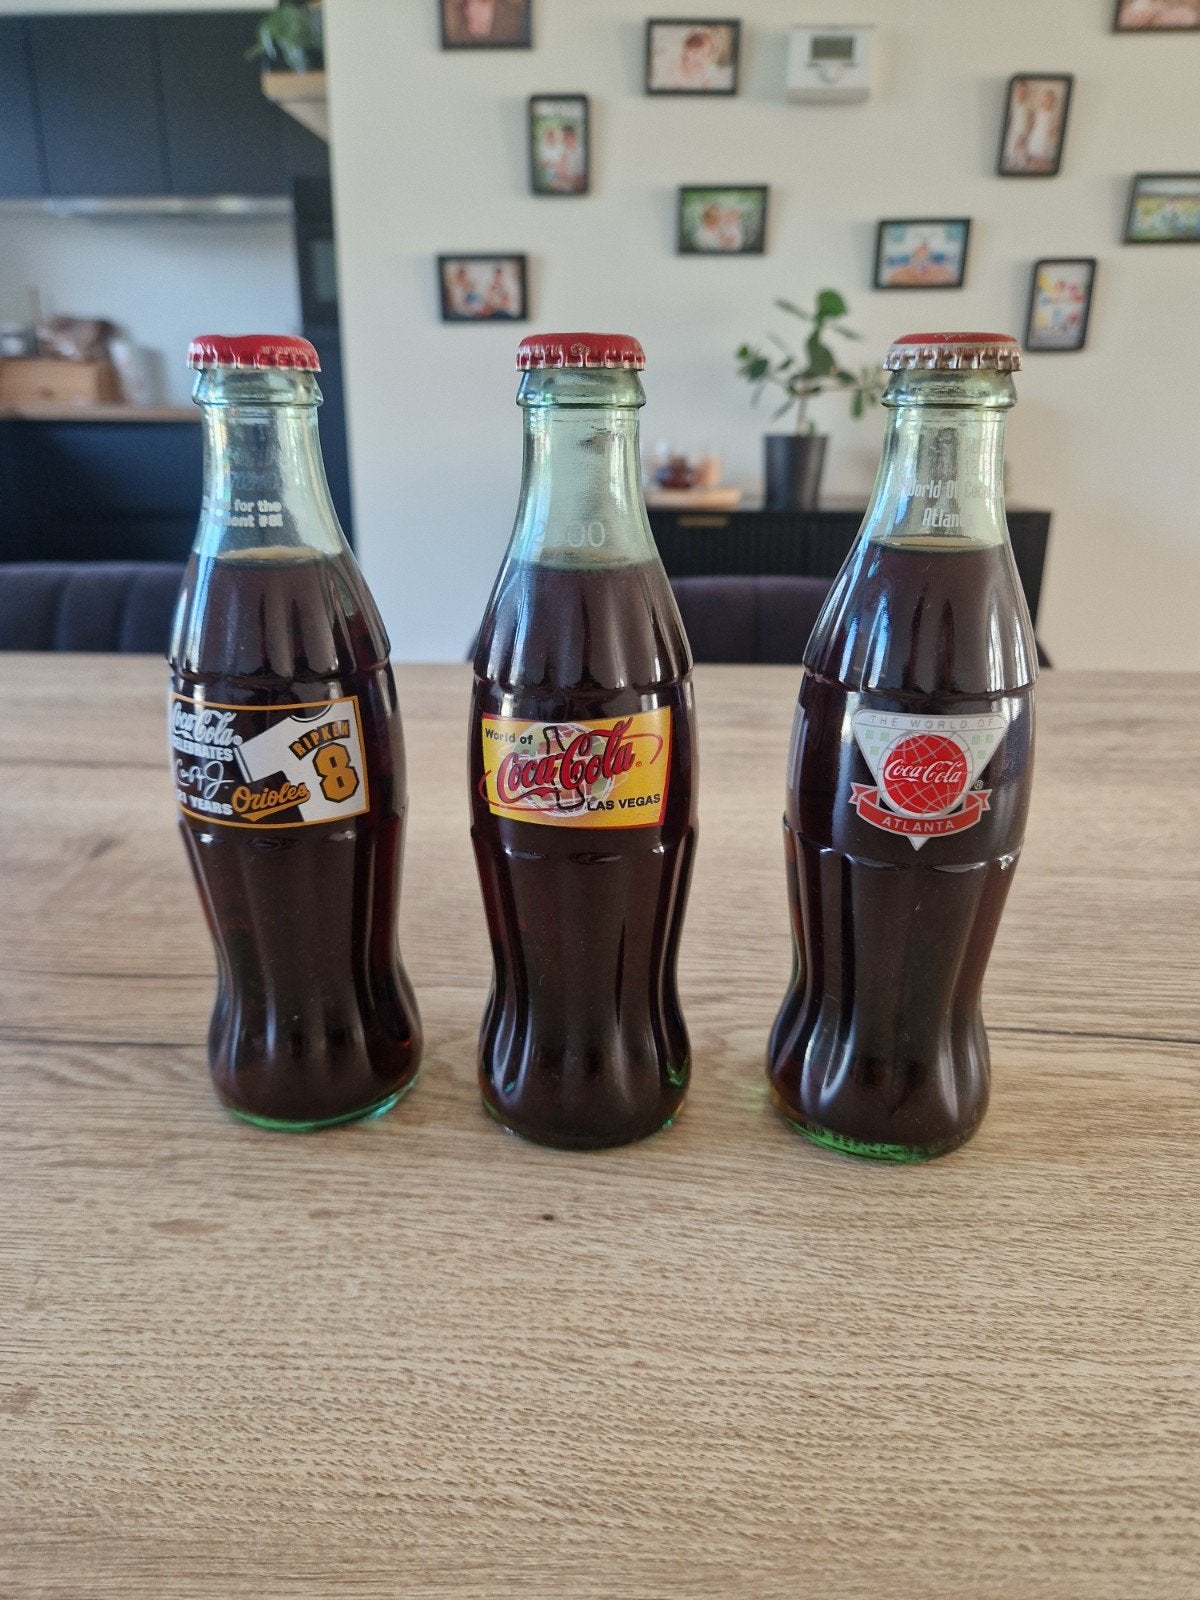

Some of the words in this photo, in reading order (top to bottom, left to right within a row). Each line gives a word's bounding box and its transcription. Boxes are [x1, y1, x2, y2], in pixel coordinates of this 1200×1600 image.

[234, 499, 255, 512] for
[257, 500, 282, 512] the
[922, 507, 970, 528] Atlan
[173, 701, 237, 747] Coca-Cola
[871, 715, 899, 727] THE
[910, 719, 968, 730] WORLD
[977, 718, 995, 728] OF
[289, 720, 351, 760] RIPKEN
[485, 728, 516, 744] World
[520, 734, 535, 746] of
[496, 717, 637, 804] Coca-Cola
[884, 758, 966, 785] Coca-Cola
[312, 742, 360, 804] 8
[189, 794, 234, 816] YEARS
[230, 782, 311, 816] Orioles
[586, 799, 615, 812] LAS
[618, 793, 661, 809] VEGAS
[881, 815, 956, 833] ATLANTA
